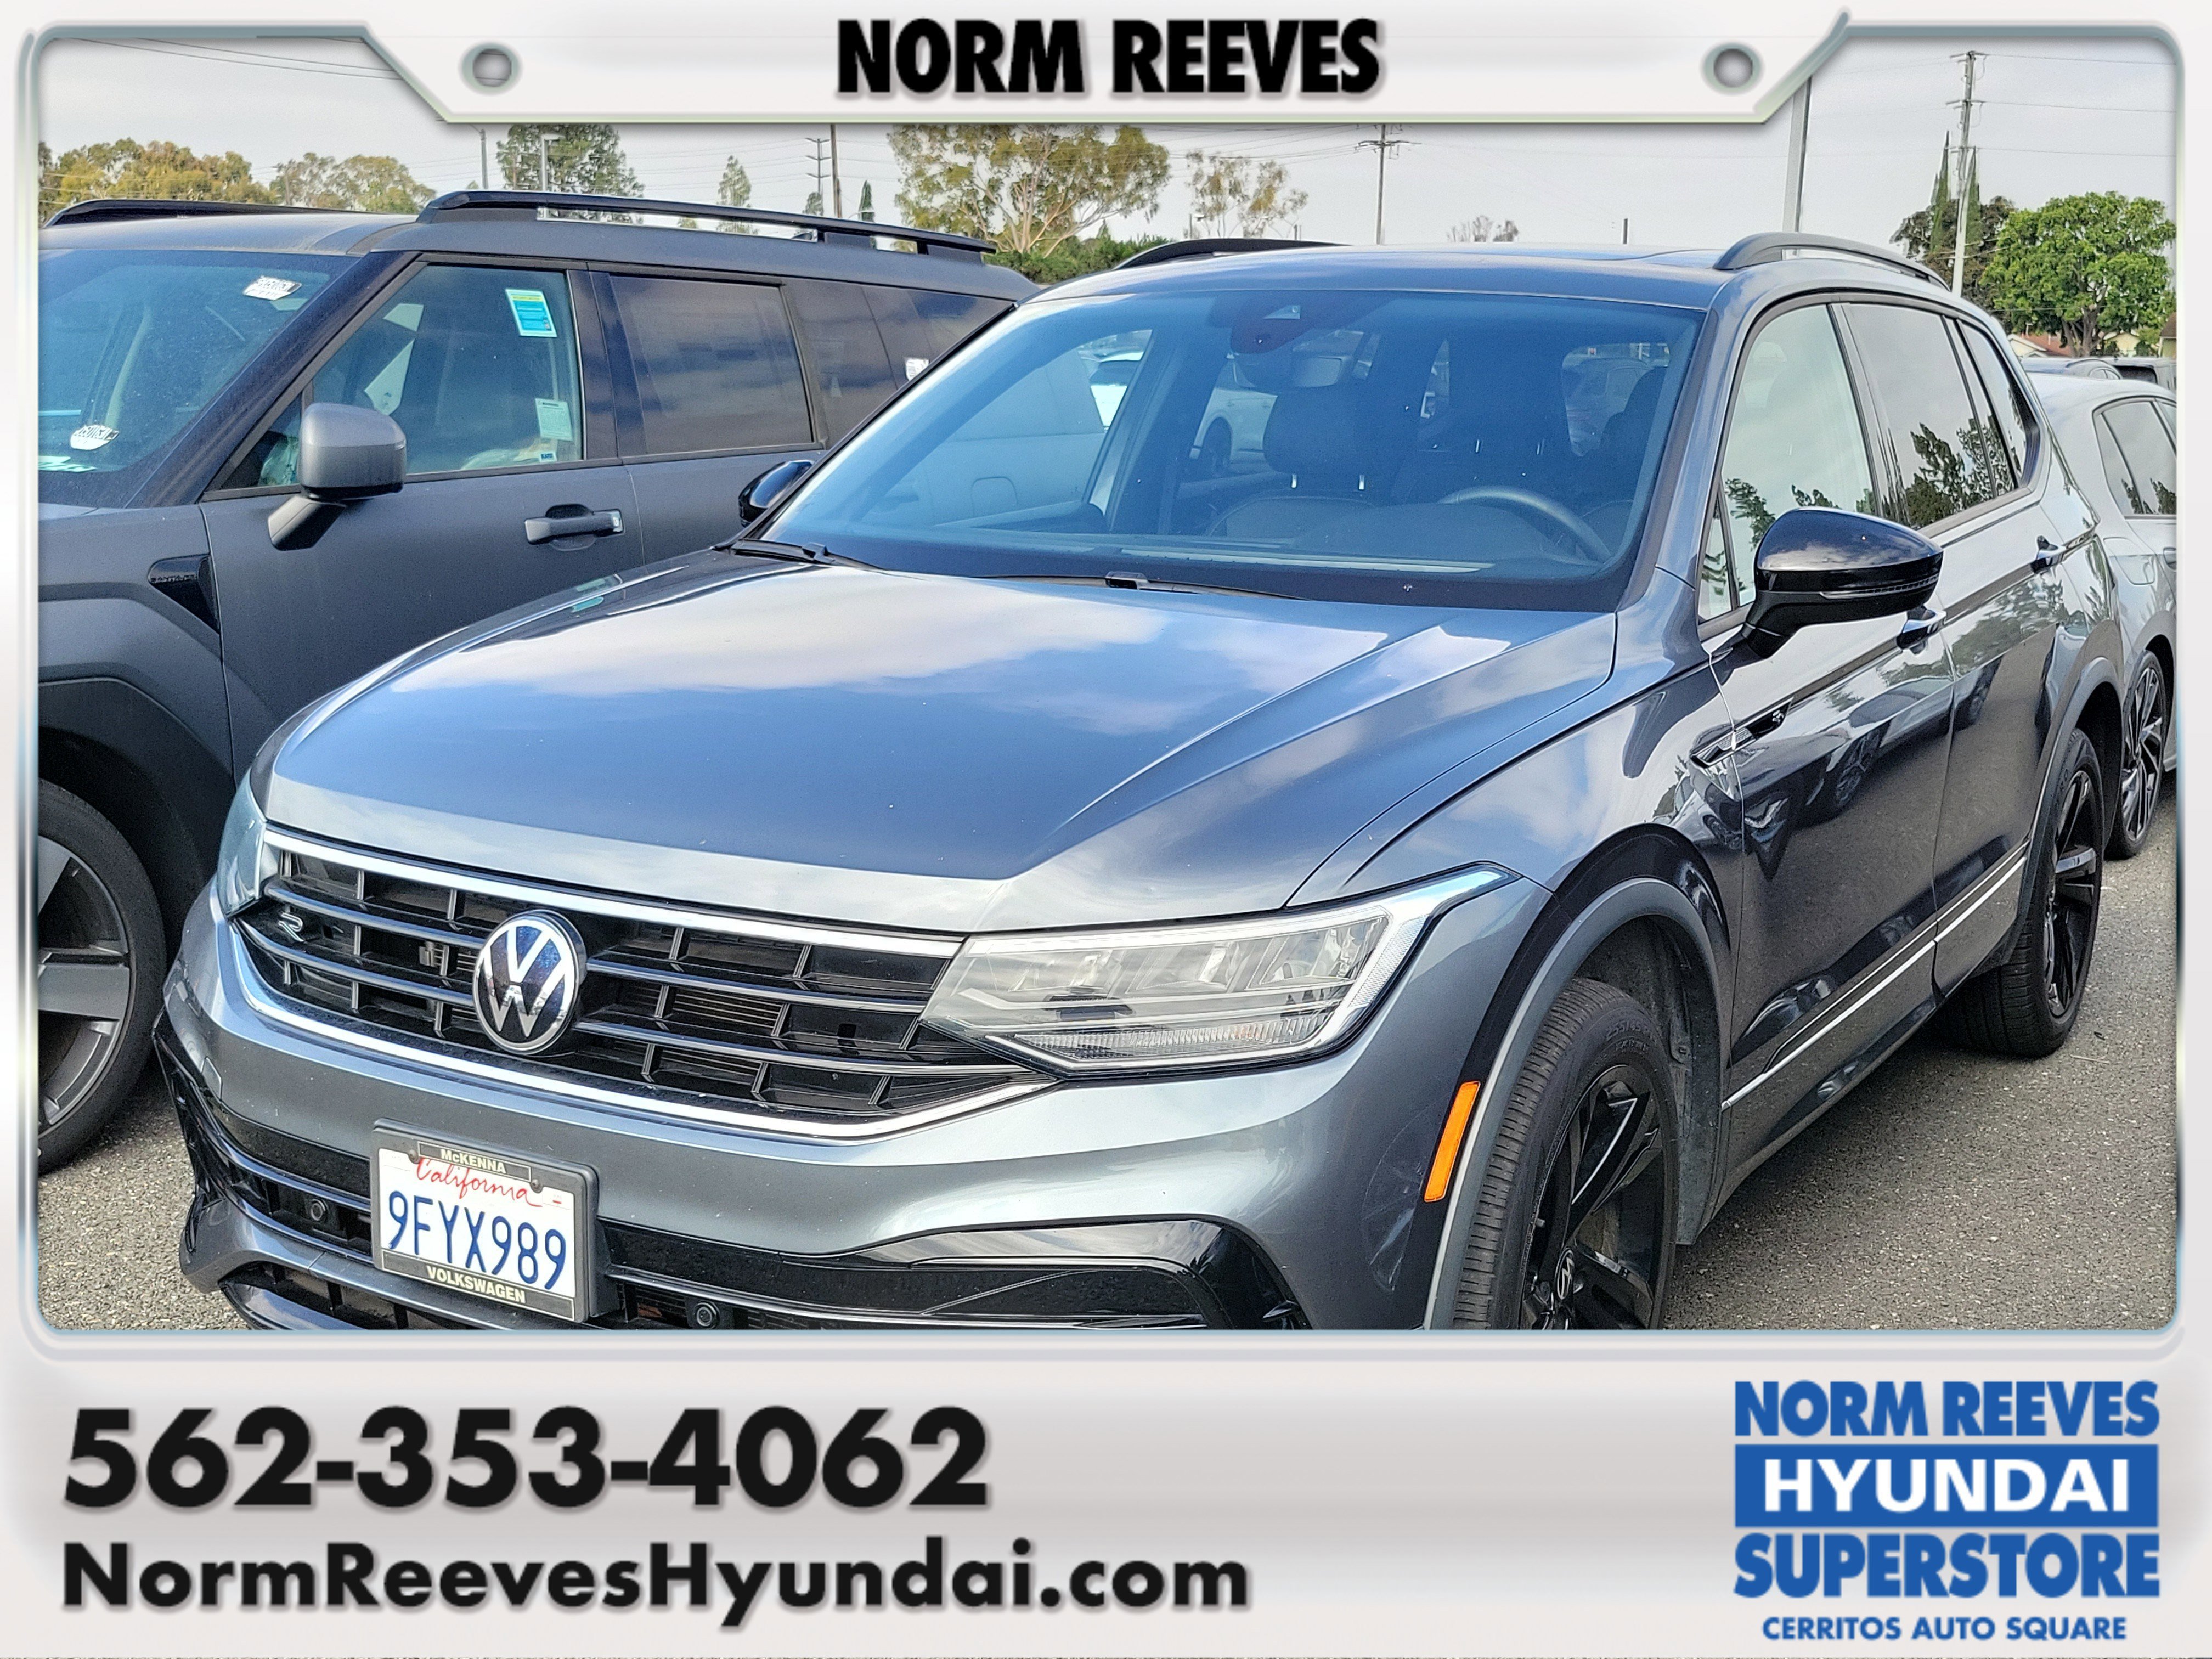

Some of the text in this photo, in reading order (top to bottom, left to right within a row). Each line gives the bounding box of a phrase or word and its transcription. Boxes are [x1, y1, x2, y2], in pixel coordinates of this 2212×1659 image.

[278, 912, 304, 943] R
[477, 920, 573, 1045] VW
[415, 1156, 543, 1207] California
[441, 1149, 506, 1175] McKENNA
[388, 1190, 566, 1290] 9FYX989
[427, 1265, 526, 1304] VOLKSWAGEN
